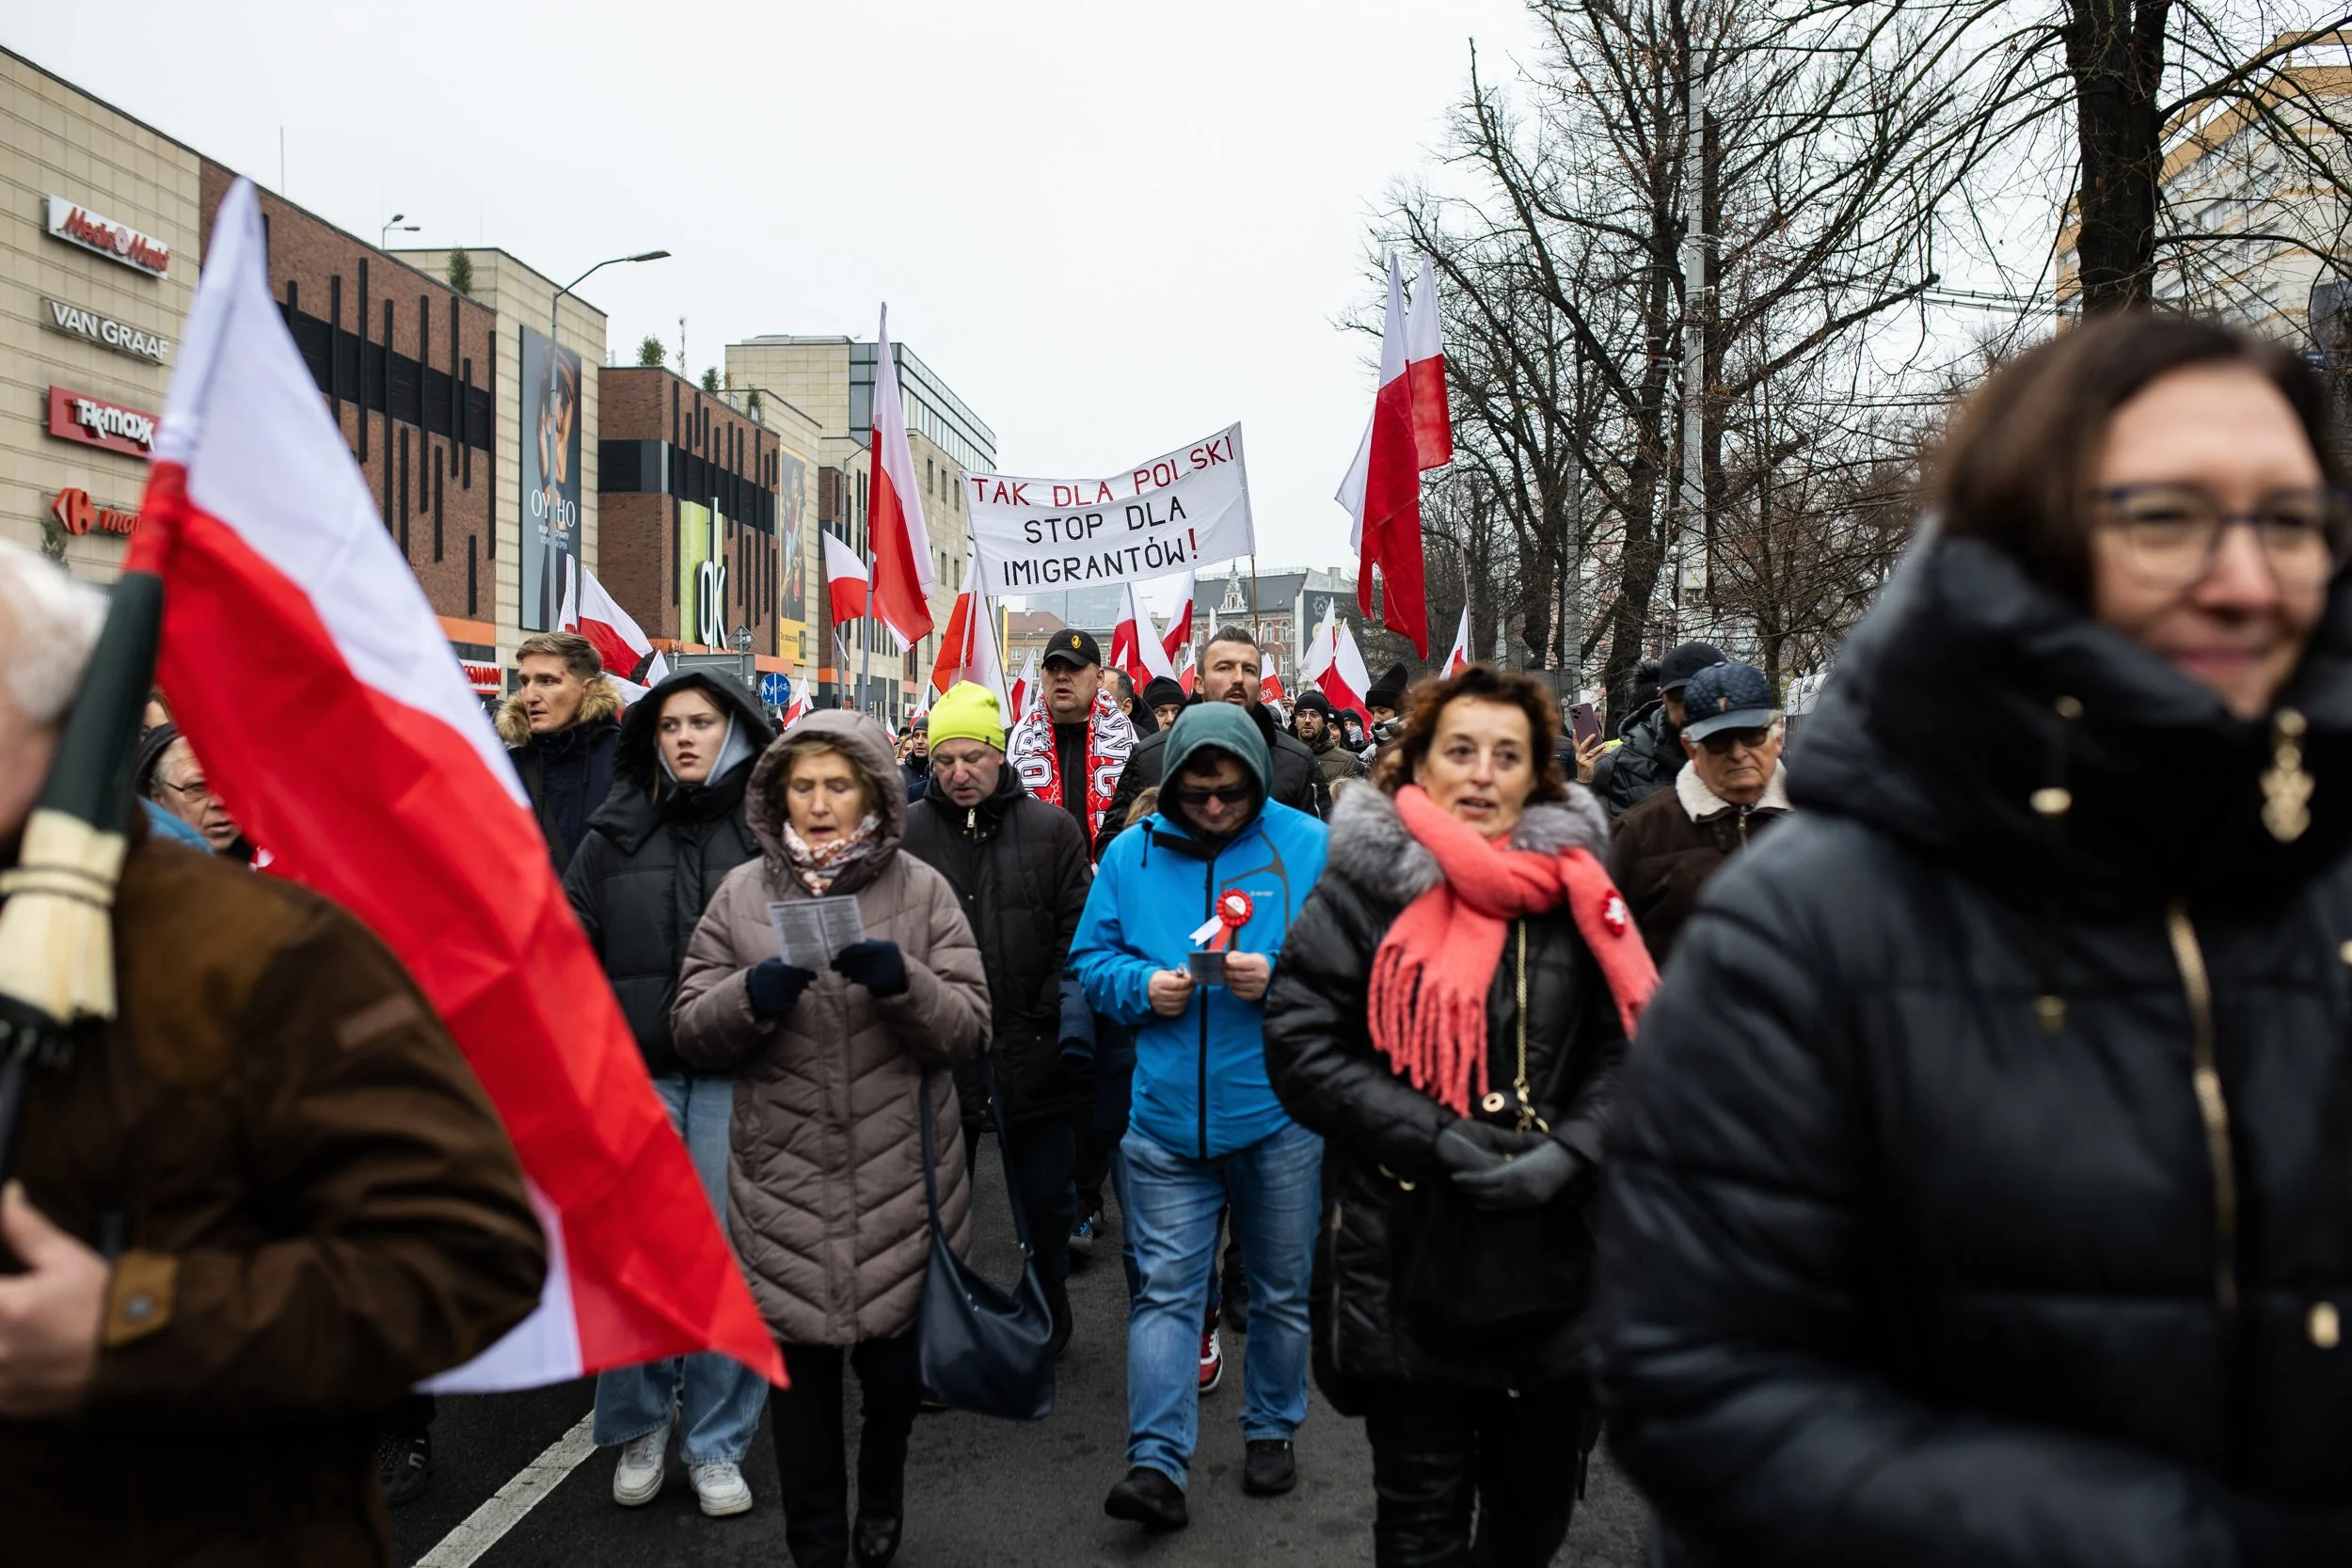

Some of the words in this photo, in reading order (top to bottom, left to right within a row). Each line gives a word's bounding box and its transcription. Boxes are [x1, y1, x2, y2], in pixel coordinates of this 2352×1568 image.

[52, 301, 98, 339] VAN
[101, 320, 169, 358] GRAAF
[971, 478, 1030, 506] TAK
[1053, 481, 1114, 508] DLA
[1134, 436, 1234, 496] POLSKI
[532, 489, 576, 528] OYHO
[1025, 513, 1104, 544] STOP
[1125, 496, 1187, 531] DLA
[1004, 528, 1199, 587] IMIGRANTÓW!
